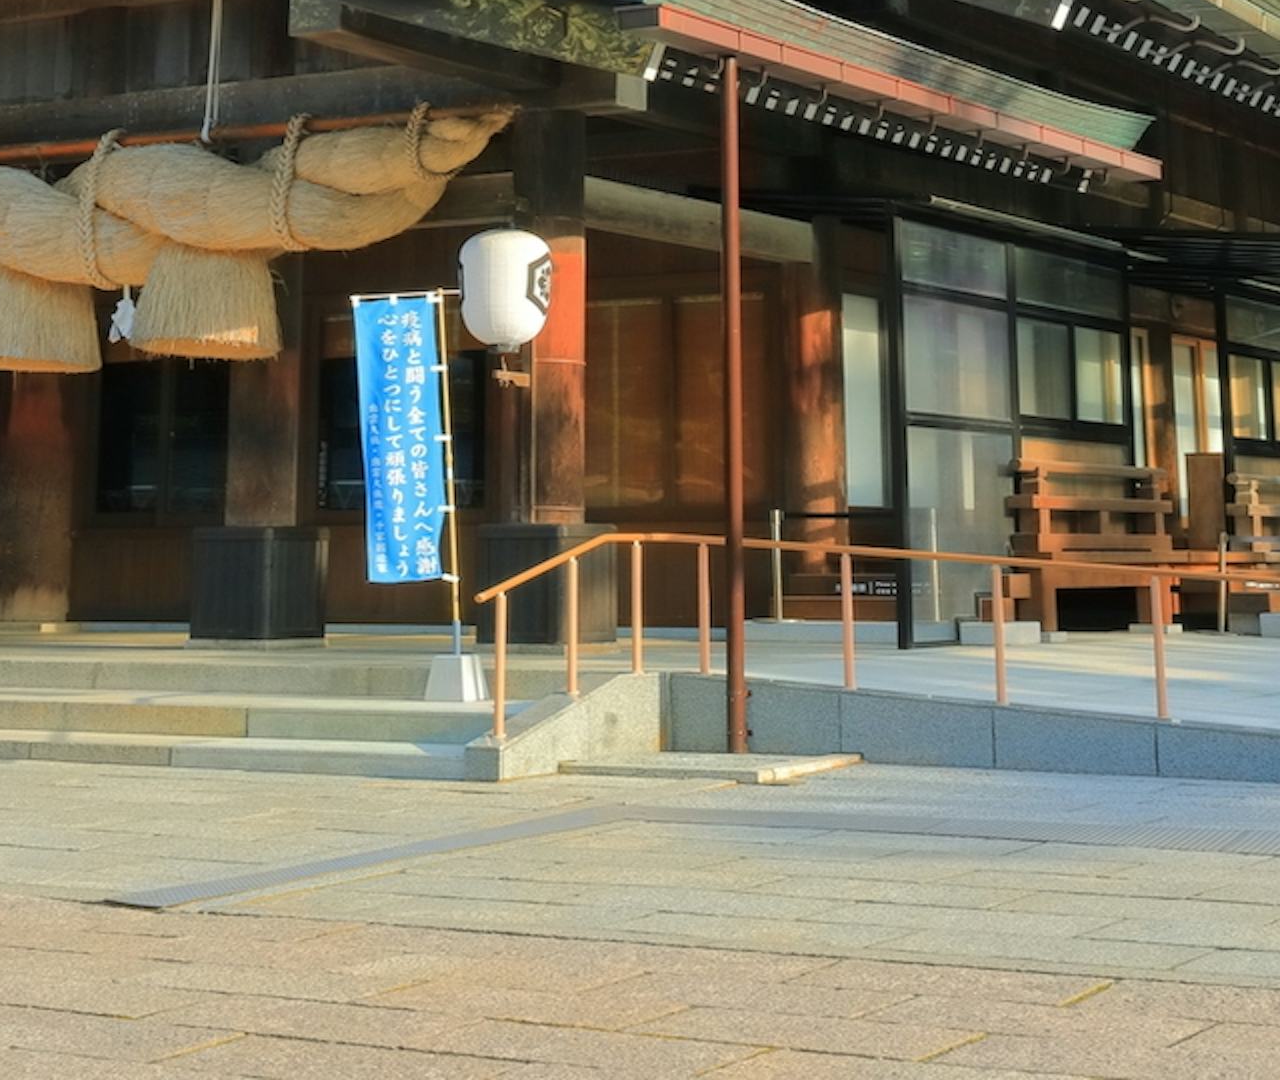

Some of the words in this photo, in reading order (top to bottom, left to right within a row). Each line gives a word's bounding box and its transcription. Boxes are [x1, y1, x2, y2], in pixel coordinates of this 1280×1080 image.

[377, 313, 409, 578] 心をひとつにして頑張りましょう
[401, 309, 438, 576] 疫病と闘う全ての皆さんへ感謝
